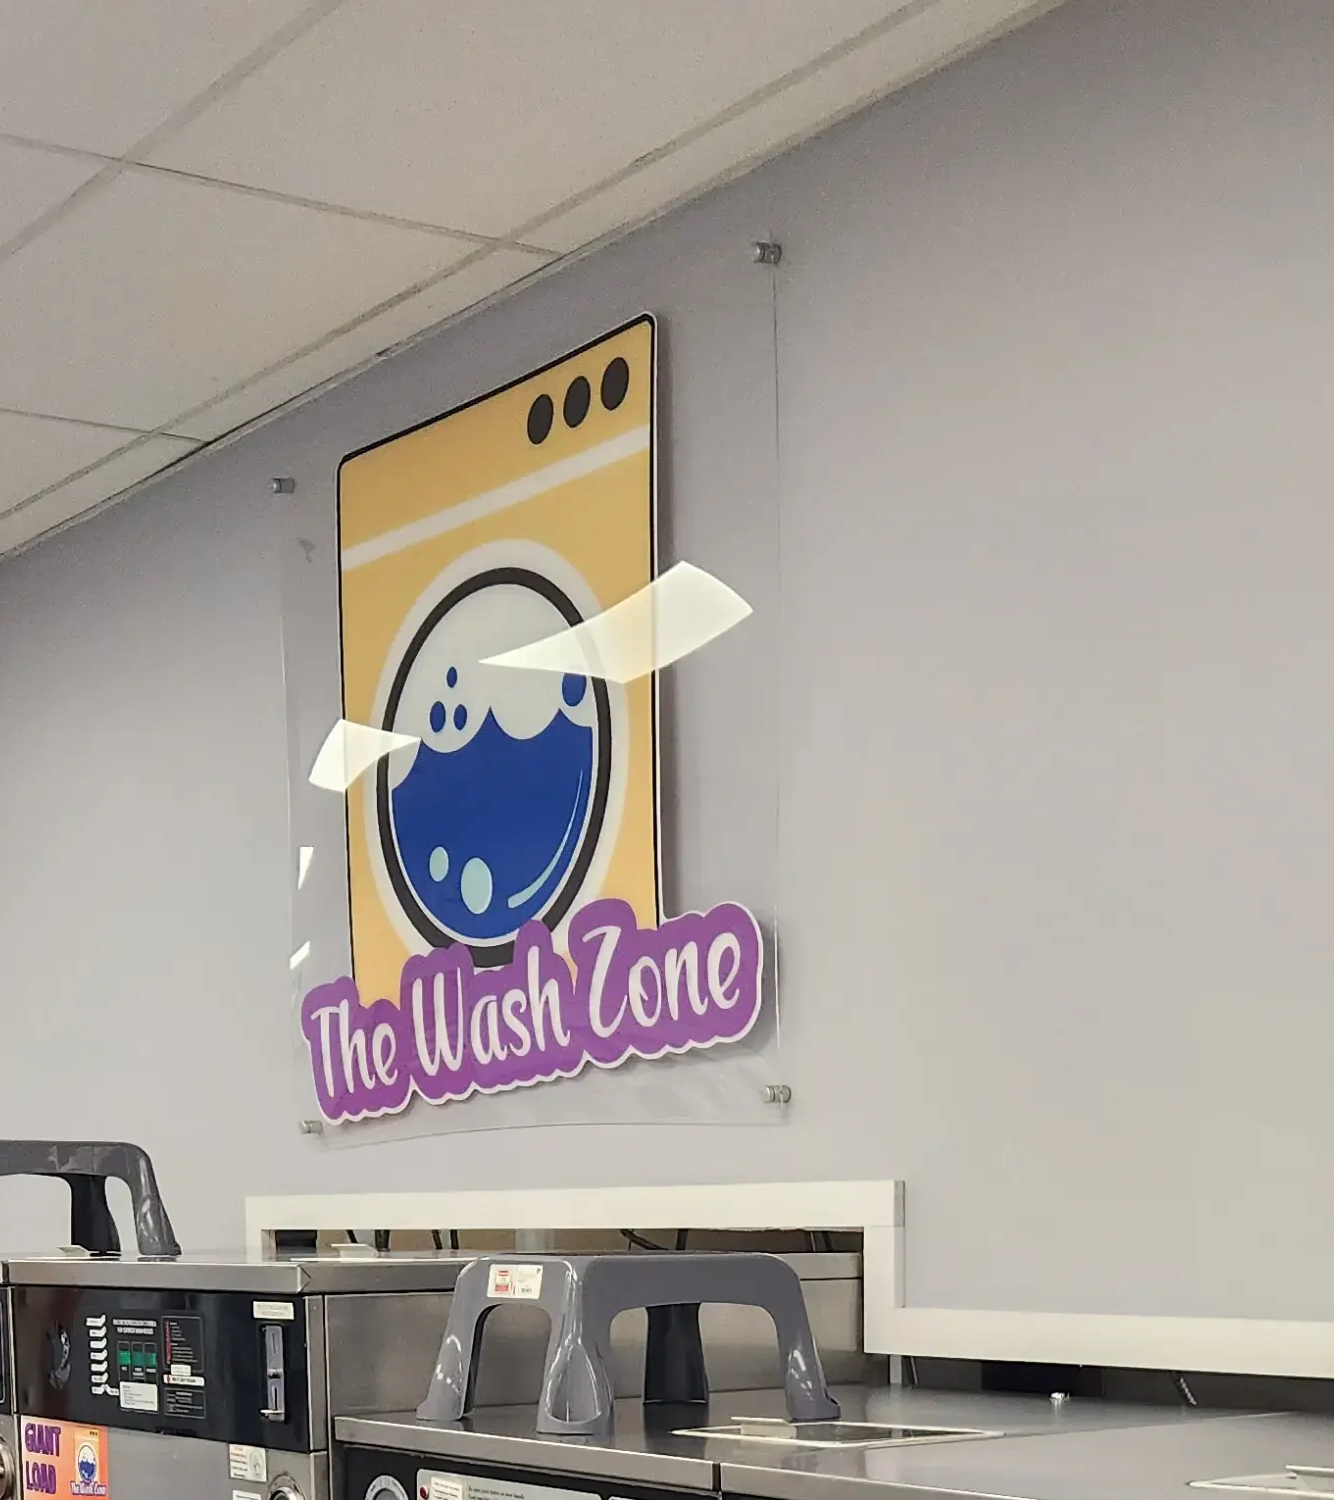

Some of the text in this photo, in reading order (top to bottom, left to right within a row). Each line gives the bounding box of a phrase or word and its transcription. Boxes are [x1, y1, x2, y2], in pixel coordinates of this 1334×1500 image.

[310, 925, 742, 1098] The Wash Zone
[25, 1422, 61, 1457] GIANT
[26, 1460, 57, 1495] LOAD
